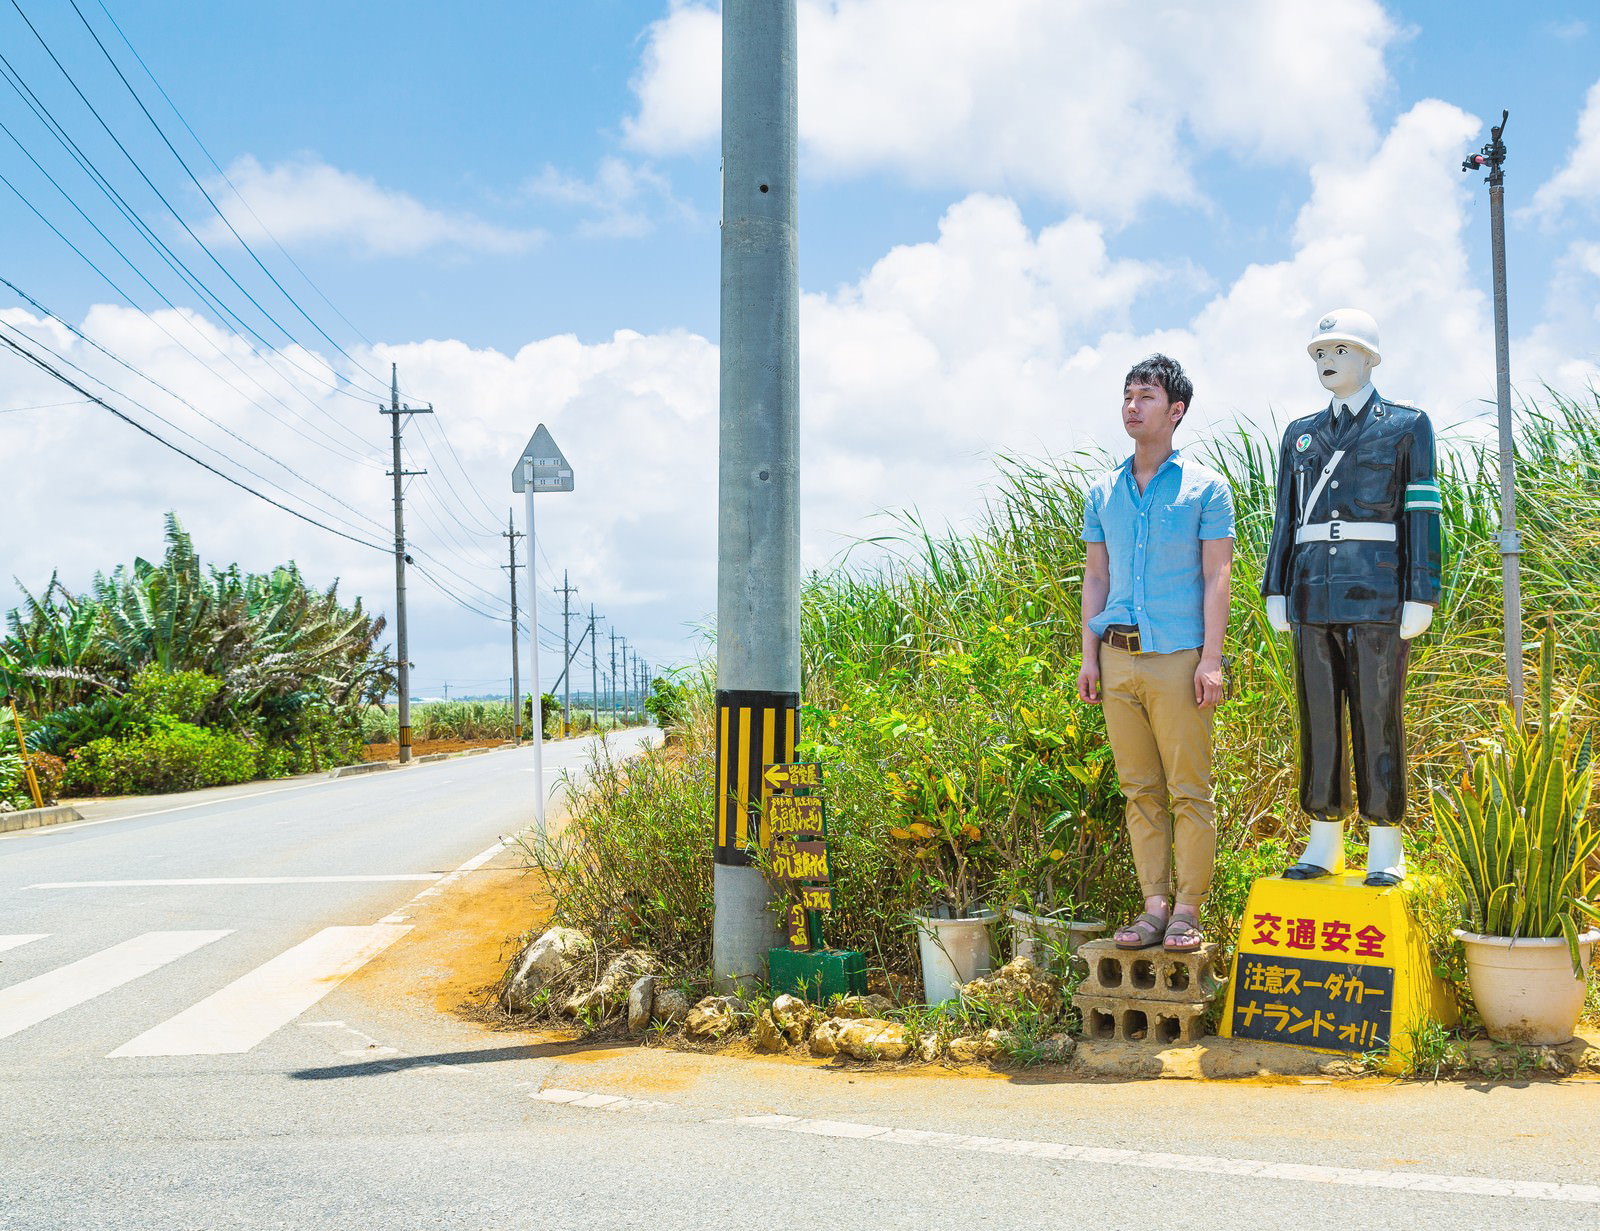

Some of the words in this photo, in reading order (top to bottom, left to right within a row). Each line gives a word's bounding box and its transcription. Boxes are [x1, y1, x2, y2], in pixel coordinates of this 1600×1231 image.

[788, 764, 818, 785] 皆愛屋
[773, 849, 829, 878] ゆし豆腐そば
[1251, 912, 1386, 958] 交通安全
[1244, 962, 1385, 1004] 注意スーダカー
